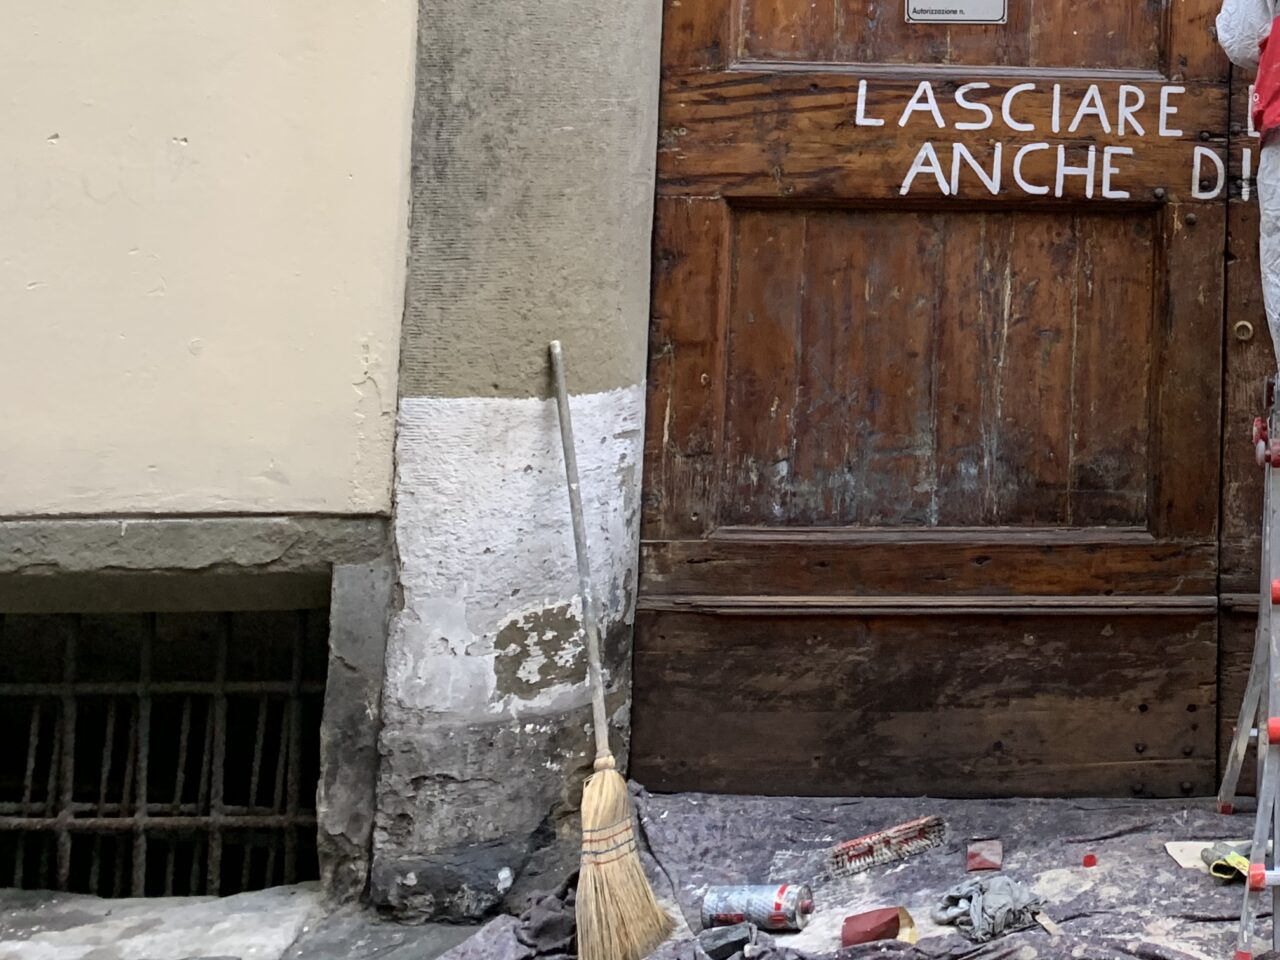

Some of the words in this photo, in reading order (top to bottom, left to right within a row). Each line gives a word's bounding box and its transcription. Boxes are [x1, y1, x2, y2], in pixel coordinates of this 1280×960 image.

[855, 80, 1186, 137] LASCIARE
[899, 142, 1134, 198] ANCHE
[1191, 146, 1251, 201] DI
